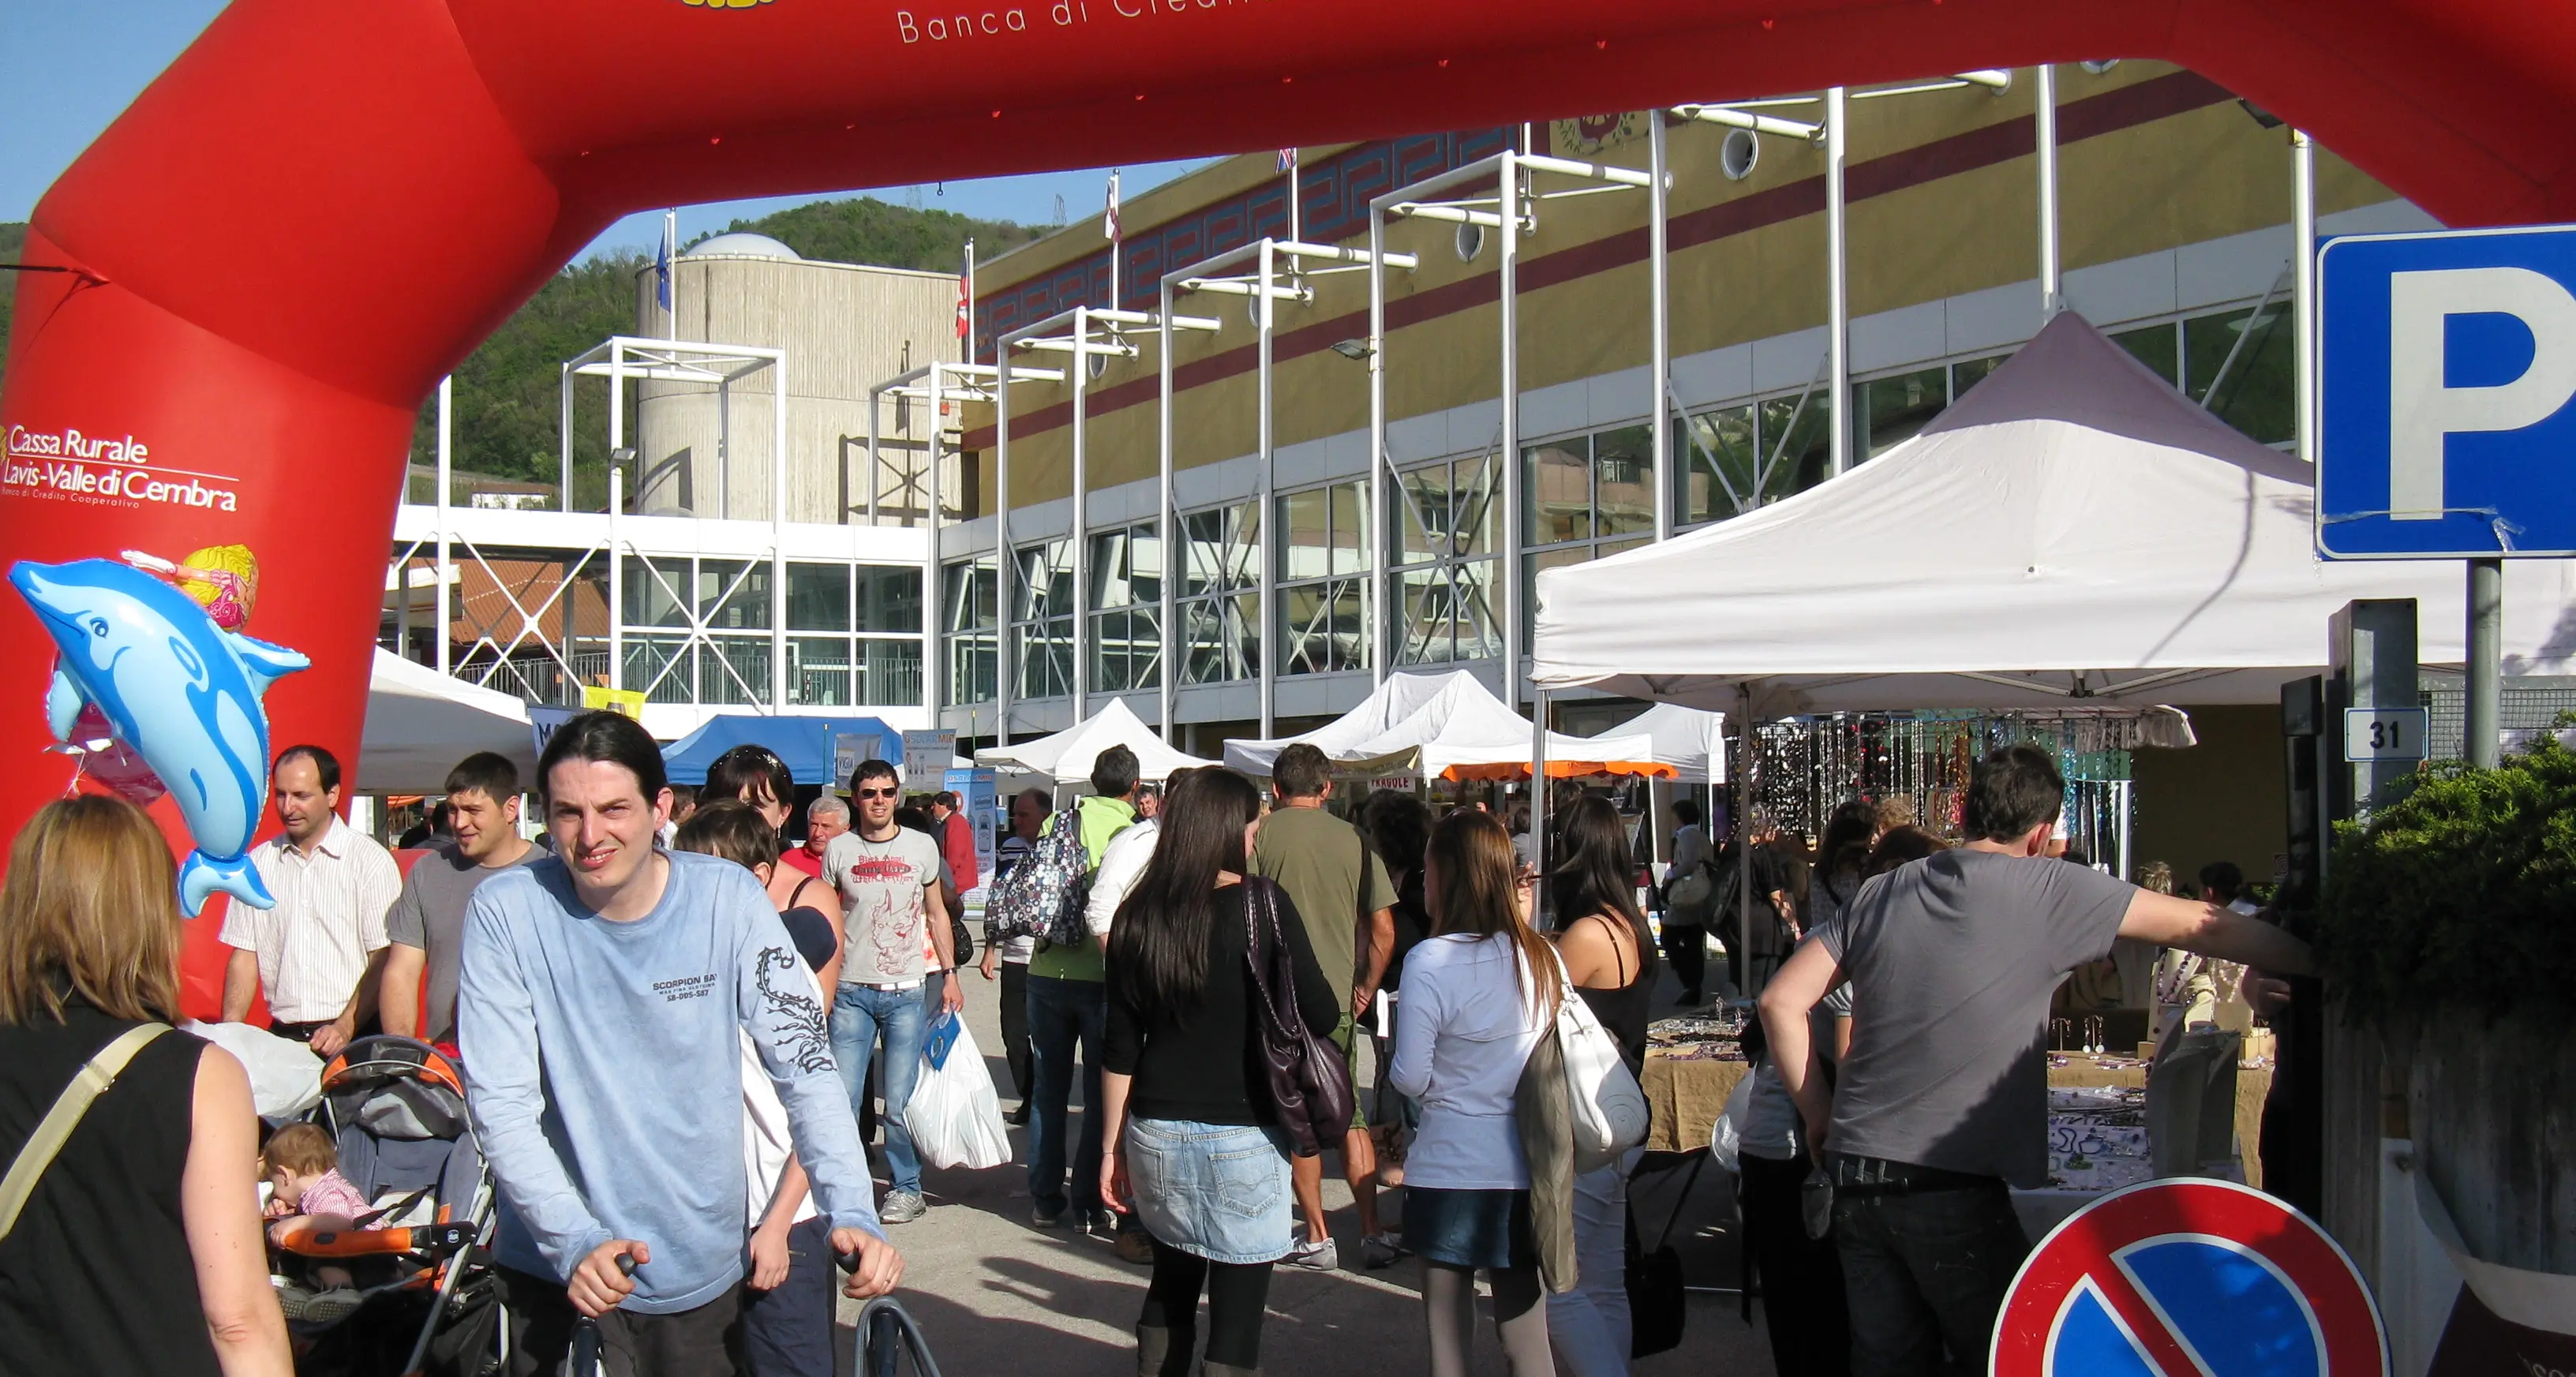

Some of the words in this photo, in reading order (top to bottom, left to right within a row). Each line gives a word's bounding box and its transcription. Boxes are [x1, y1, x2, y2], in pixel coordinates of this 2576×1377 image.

[897, 9, 1027, 44] Banca
[1051, 0, 1088, 26] di
[2391, 267, 2576, 521] P
[9, 425, 61, 455] Cassa
[65, 429, 148, 464] Rurale
[4, 458, 96, 493] Lavis-Valle
[98, 468, 122, 496] di
[123, 471, 238, 512] Cembra
[32, 489, 66, 501] Credito
[70, 492, 140, 509] Cooperativo
[2370, 720, 2398, 750] 31
[653, 976, 702, 991] SCORPION
